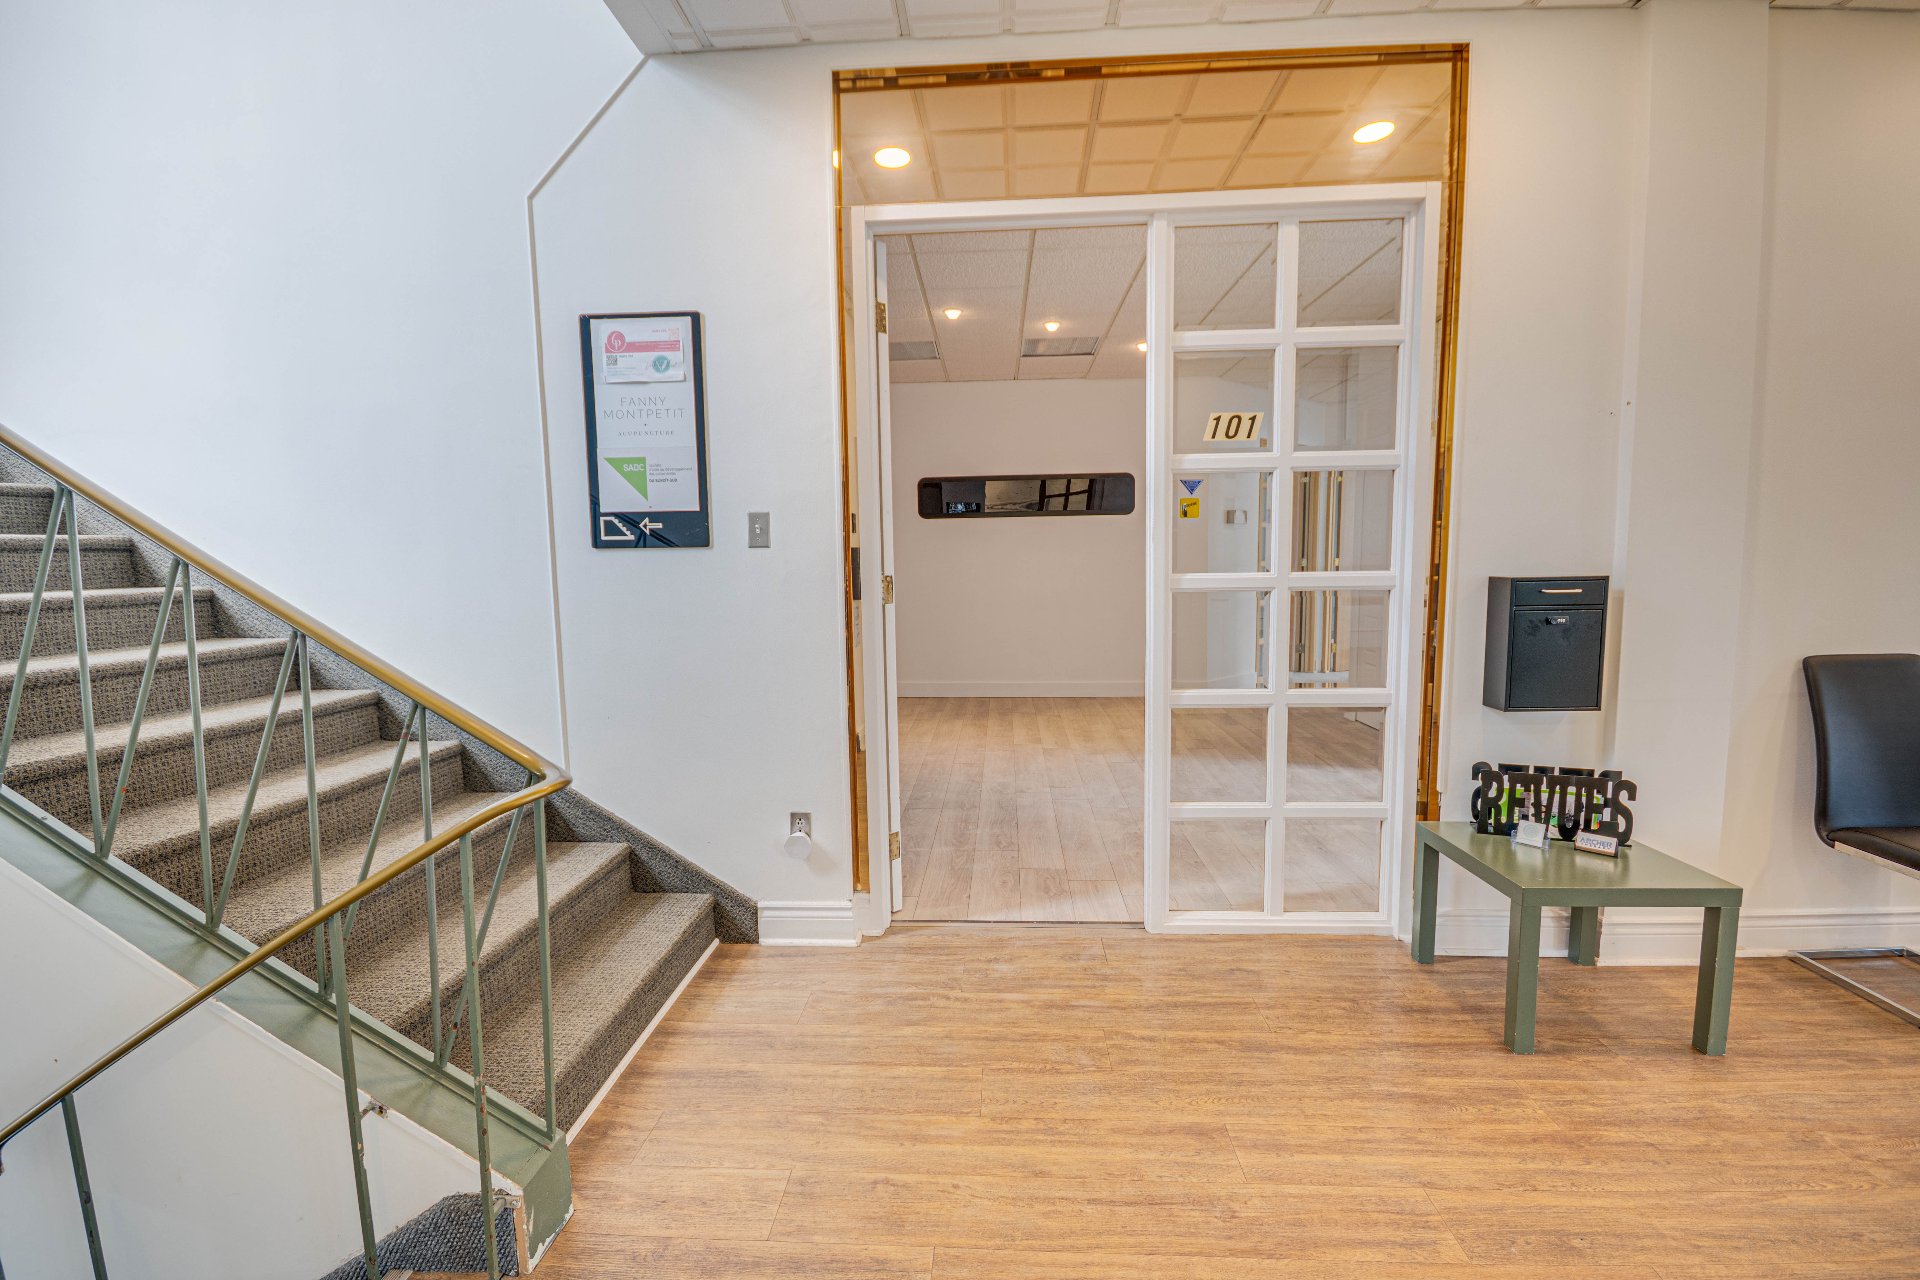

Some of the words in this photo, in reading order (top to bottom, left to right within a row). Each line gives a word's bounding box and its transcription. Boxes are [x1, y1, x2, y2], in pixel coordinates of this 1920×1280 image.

[620, 396, 666, 407] FANNY
[603, 408, 686, 420] MONTPETIT
[1211, 414, 1257, 440] 101
[622, 463, 646, 472] SADC
[1477, 769, 1638, 847] REVUES
[1579, 836, 1613, 848] ARCHER
